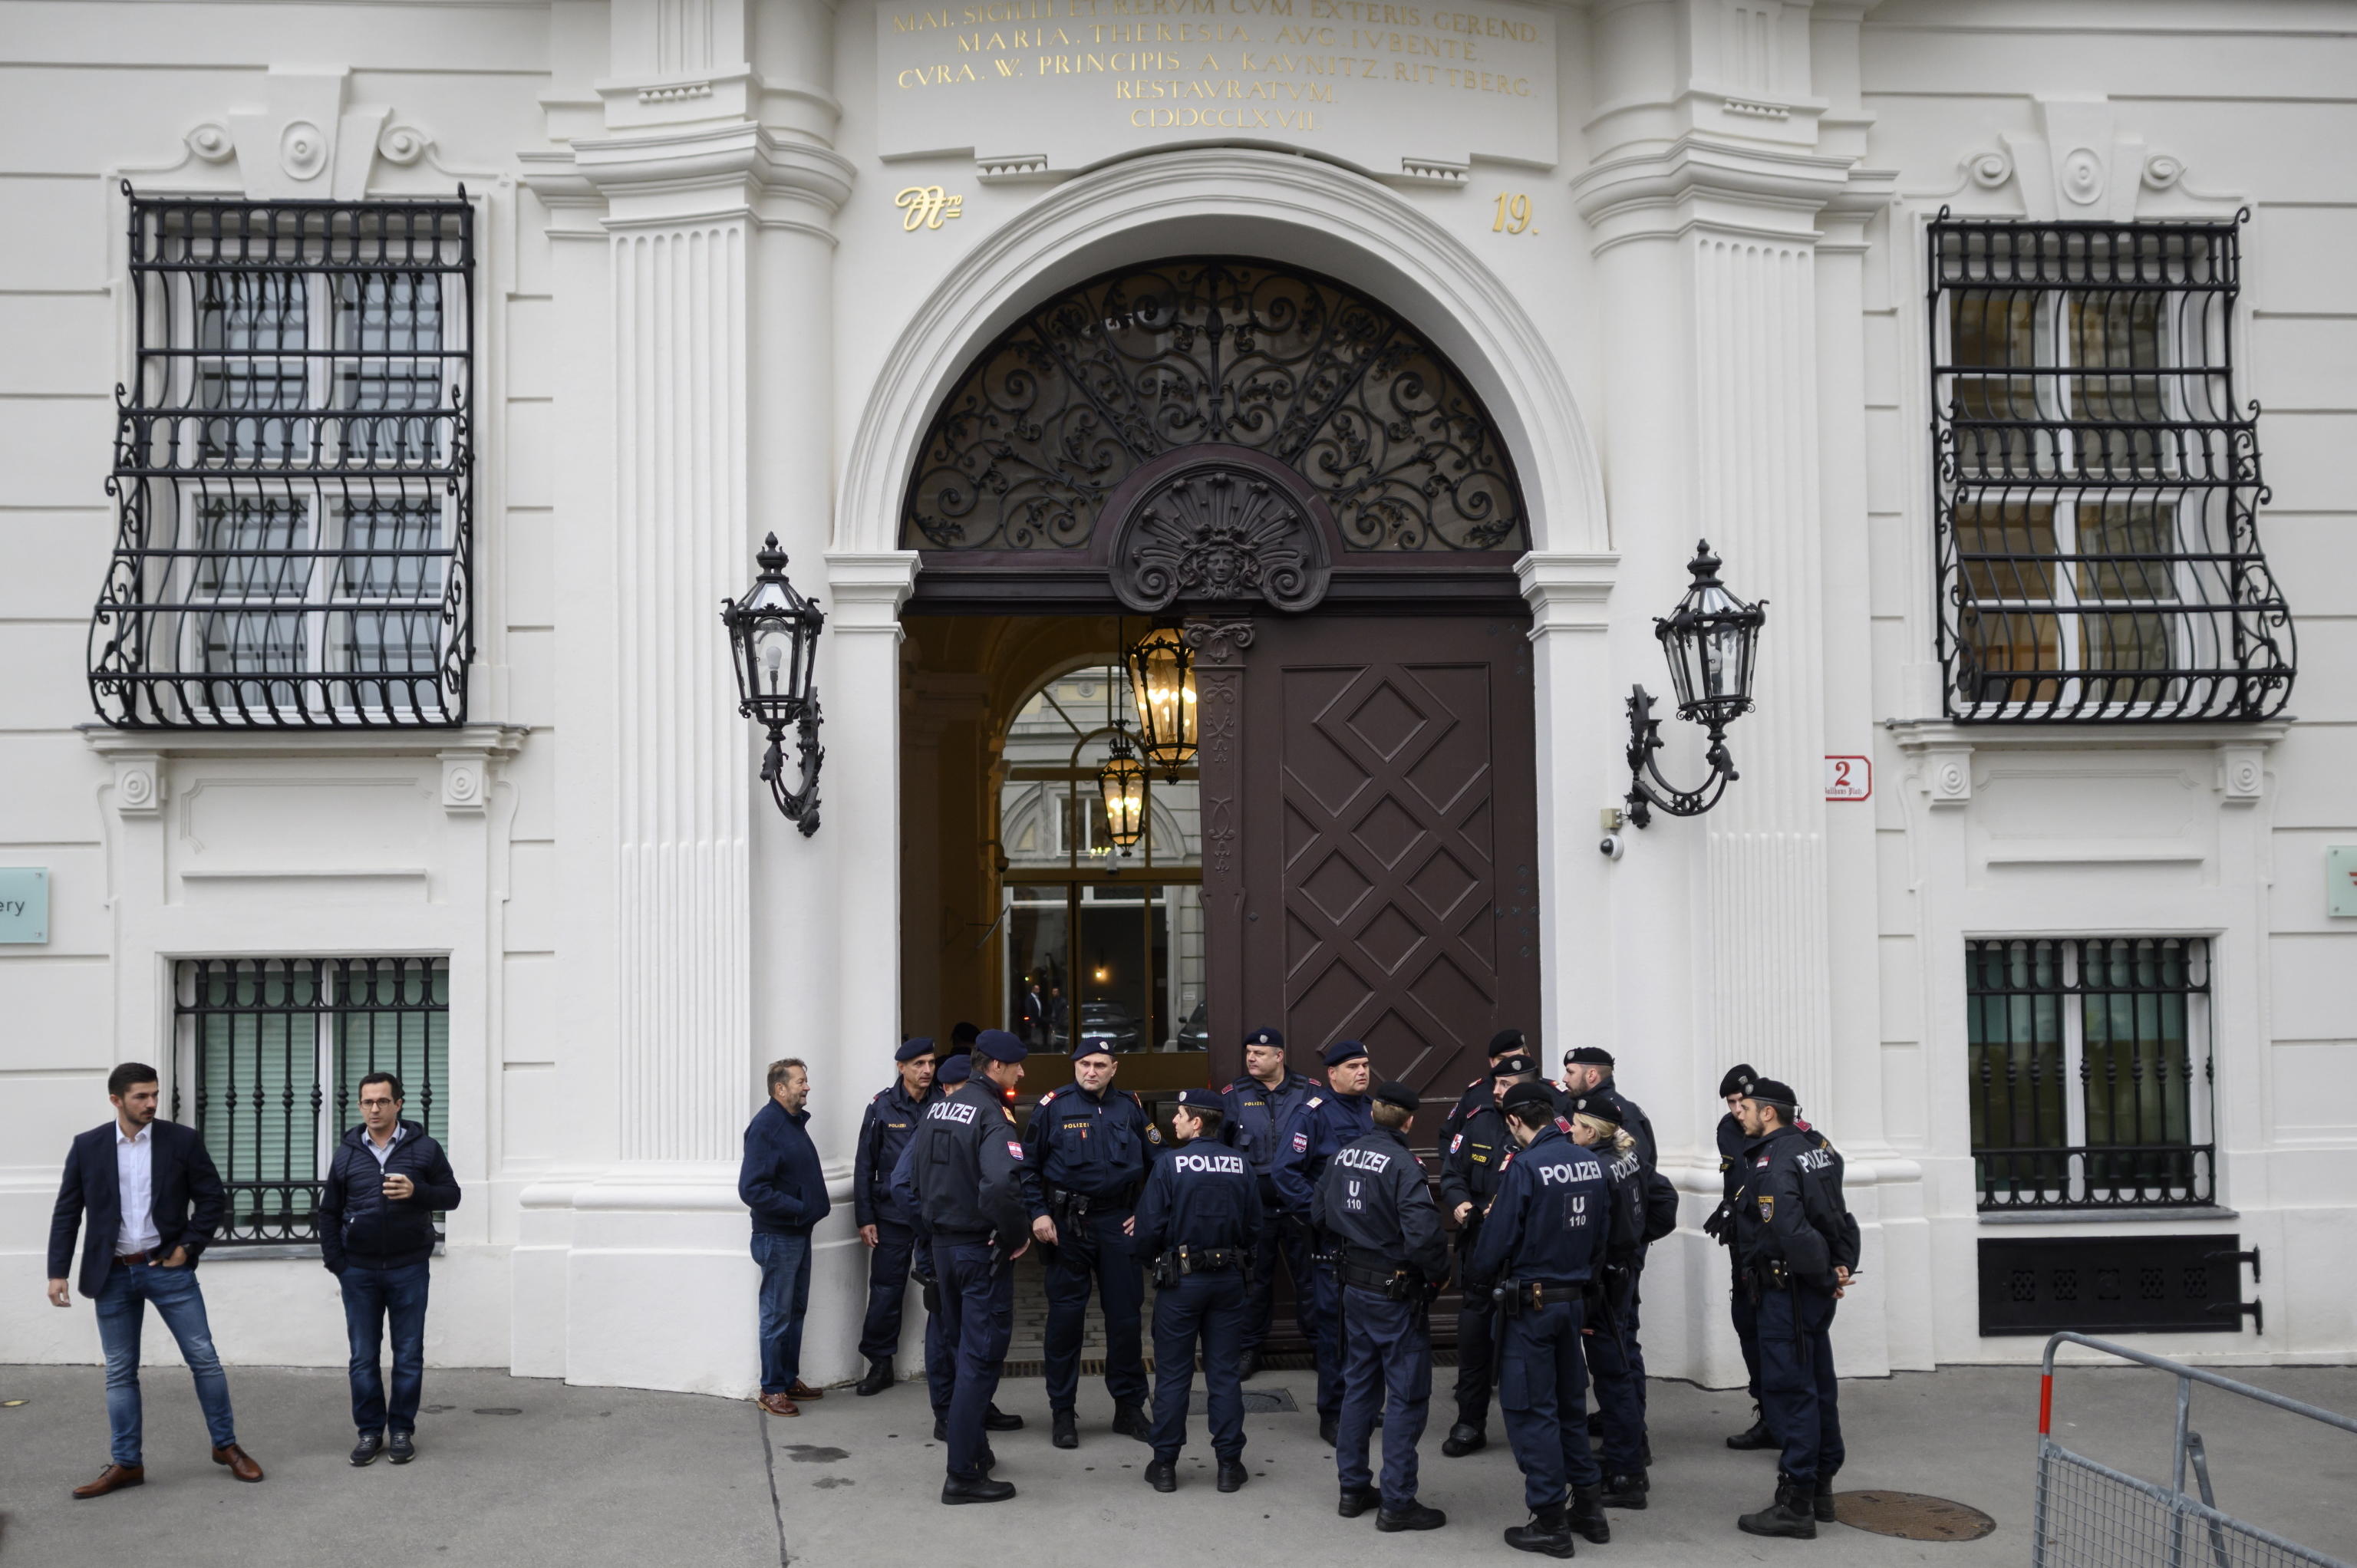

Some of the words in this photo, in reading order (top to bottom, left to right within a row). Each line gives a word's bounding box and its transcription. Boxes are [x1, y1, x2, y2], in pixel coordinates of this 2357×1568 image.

[1835, 760, 1851, 787] 2
[926, 1102, 977, 1125] POLIZEI
[1175, 1155, 1244, 1174] POLIZEI
[1334, 1148, 1391, 1174] POLIZEI
[1538, 1161, 1602, 1186] POLIZEI
[1349, 1180, 1360, 1197] U
[1347, 1198, 1362, 1210] 110
[1572, 1196, 1585, 1214] U
[1569, 1214, 1587, 1227] 110
